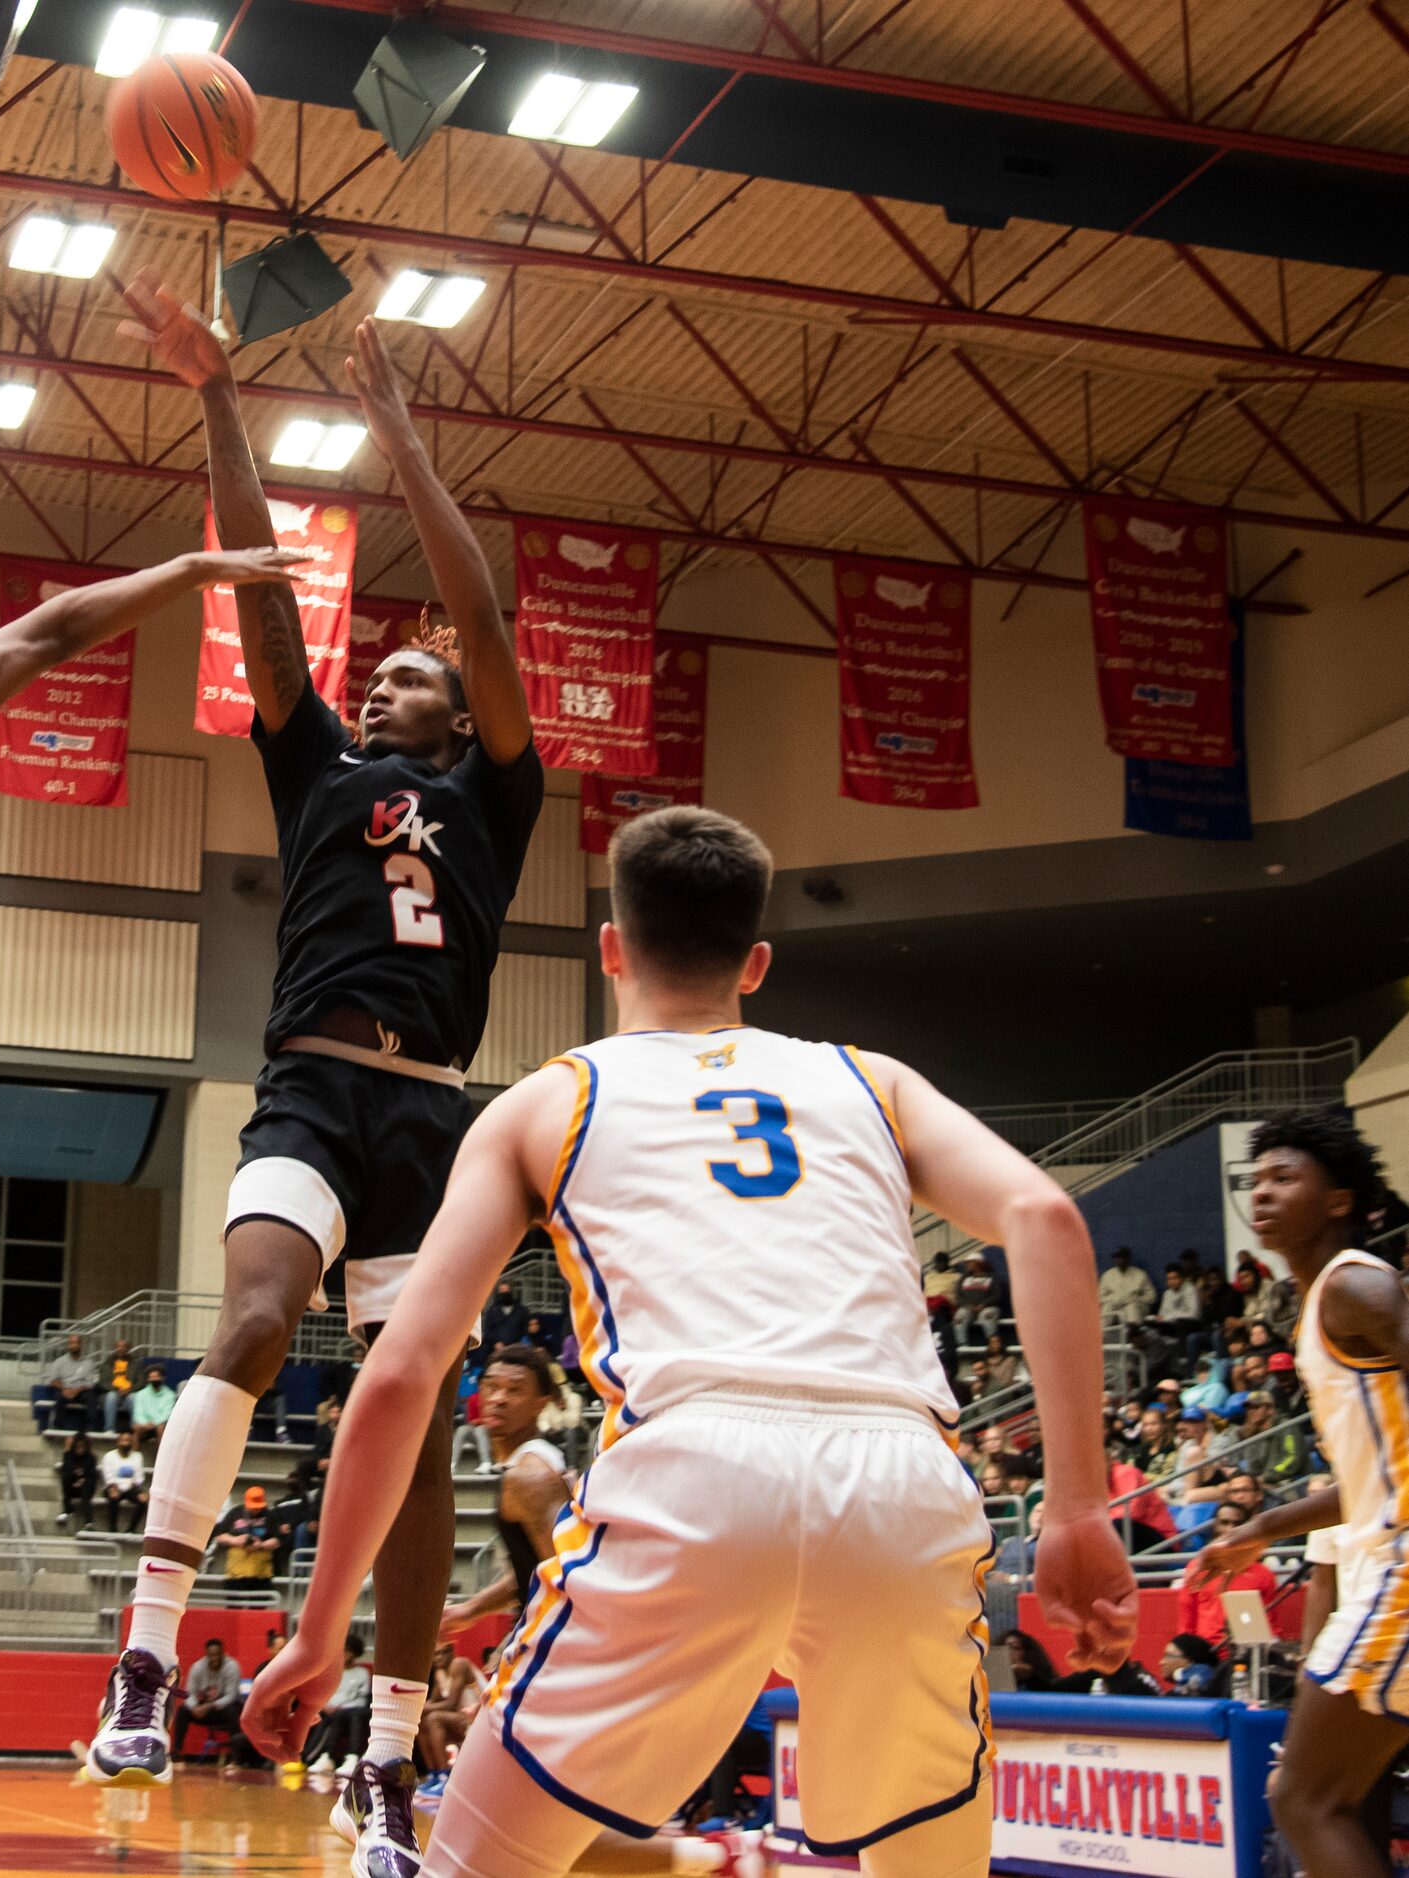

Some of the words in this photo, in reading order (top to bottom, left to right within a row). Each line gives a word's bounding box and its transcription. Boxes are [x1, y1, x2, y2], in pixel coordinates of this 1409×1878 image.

[1107, 557, 1207, 584] Duncanville
[536, 573, 637, 599] Duncanville
[1138, 586, 1224, 610] Basketball
[520, 595, 564, 615] Girls
[567, 602, 651, 624] Basketball
[854, 612, 952, 637] Duncanville
[568, 643, 604, 661] 2016
[519, 657, 580, 677] National
[1137, 659, 1152, 672] of
[1154, 660, 1176, 675] the
[46, 688, 82, 705] 2012
[202, 686, 219, 701] 25
[0, 744, 58, 769] Freeman
[43, 779, 77, 796] 40-1
[382, 851, 446, 949] 2
[690, 1087, 806, 1201] 3
[1065, 1743, 1106, 1757] WELCOME
[992, 1759, 1225, 1848] UNCANVILLE
[1085, 1841, 1132, 1863] SCHOOL
